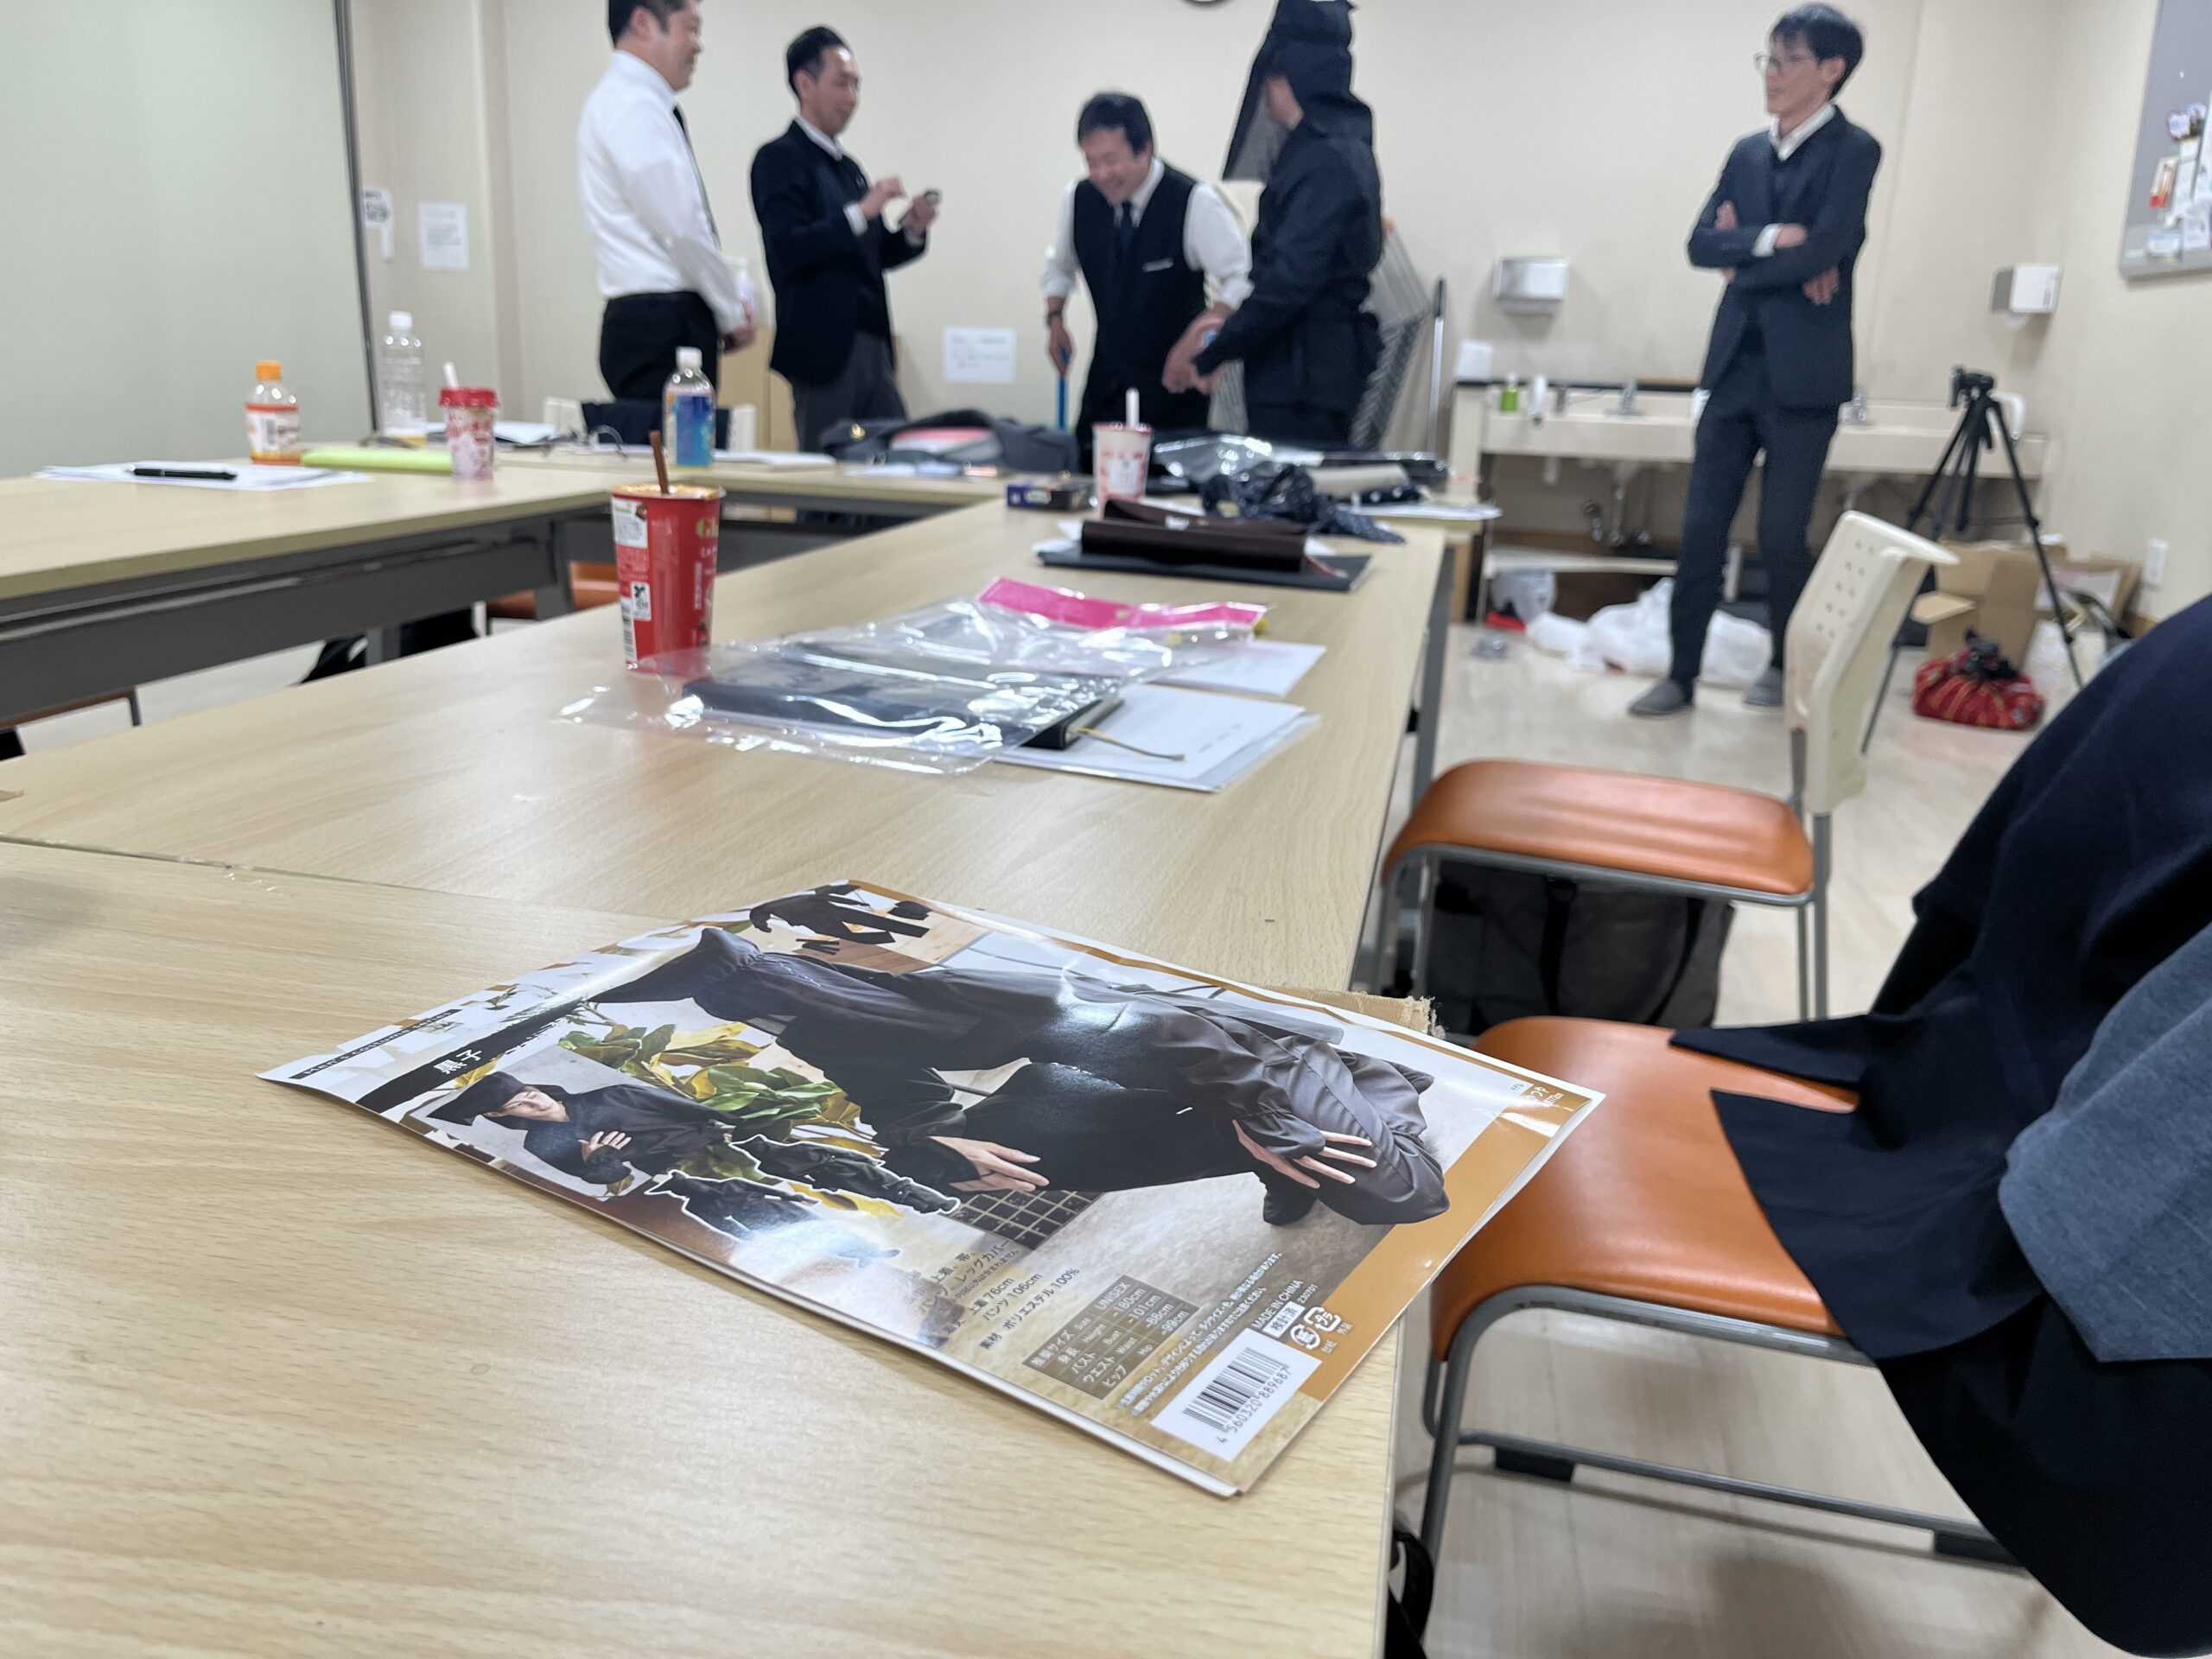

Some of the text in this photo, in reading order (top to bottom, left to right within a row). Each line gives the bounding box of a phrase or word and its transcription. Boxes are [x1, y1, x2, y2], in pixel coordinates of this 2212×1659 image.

[352, 1028, 414, 1055] costume
[412, 1011, 453, 1029] series
[433, 1048, 482, 1075] 黒子
[968, 1296, 988, 1316] 上着
[984, 1277, 1015, 1301] 76cm
[979, 1267, 1080, 1350] 素材 ポリエステル 100%
[982, 1273, 1043, 1321] パンツ 106cm
[1073, 1317, 1092, 1331] Size
[1095, 1282, 1131, 1310] UNISEX
[1251, 1280, 1304, 1329] MADE IN CHINA
[1058, 1345, 1080, 1365] 身長
[1082, 1323, 1107, 1343] Height
[1070, 1351, 1096, 1375] バスト
[1103, 1330, 1122, 1346] Bust
[1082, 1356, 1116, 1383] ウエスト
[1115, 1337, 1139, 1356] Waist
[1102, 1364, 1127, 1389] ヒップ
[1137, 1343, 1154, 1357] Hip
[1225, 1398, 1262, 1433] 560320
[1258, 1367, 1292, 1399] 889687
